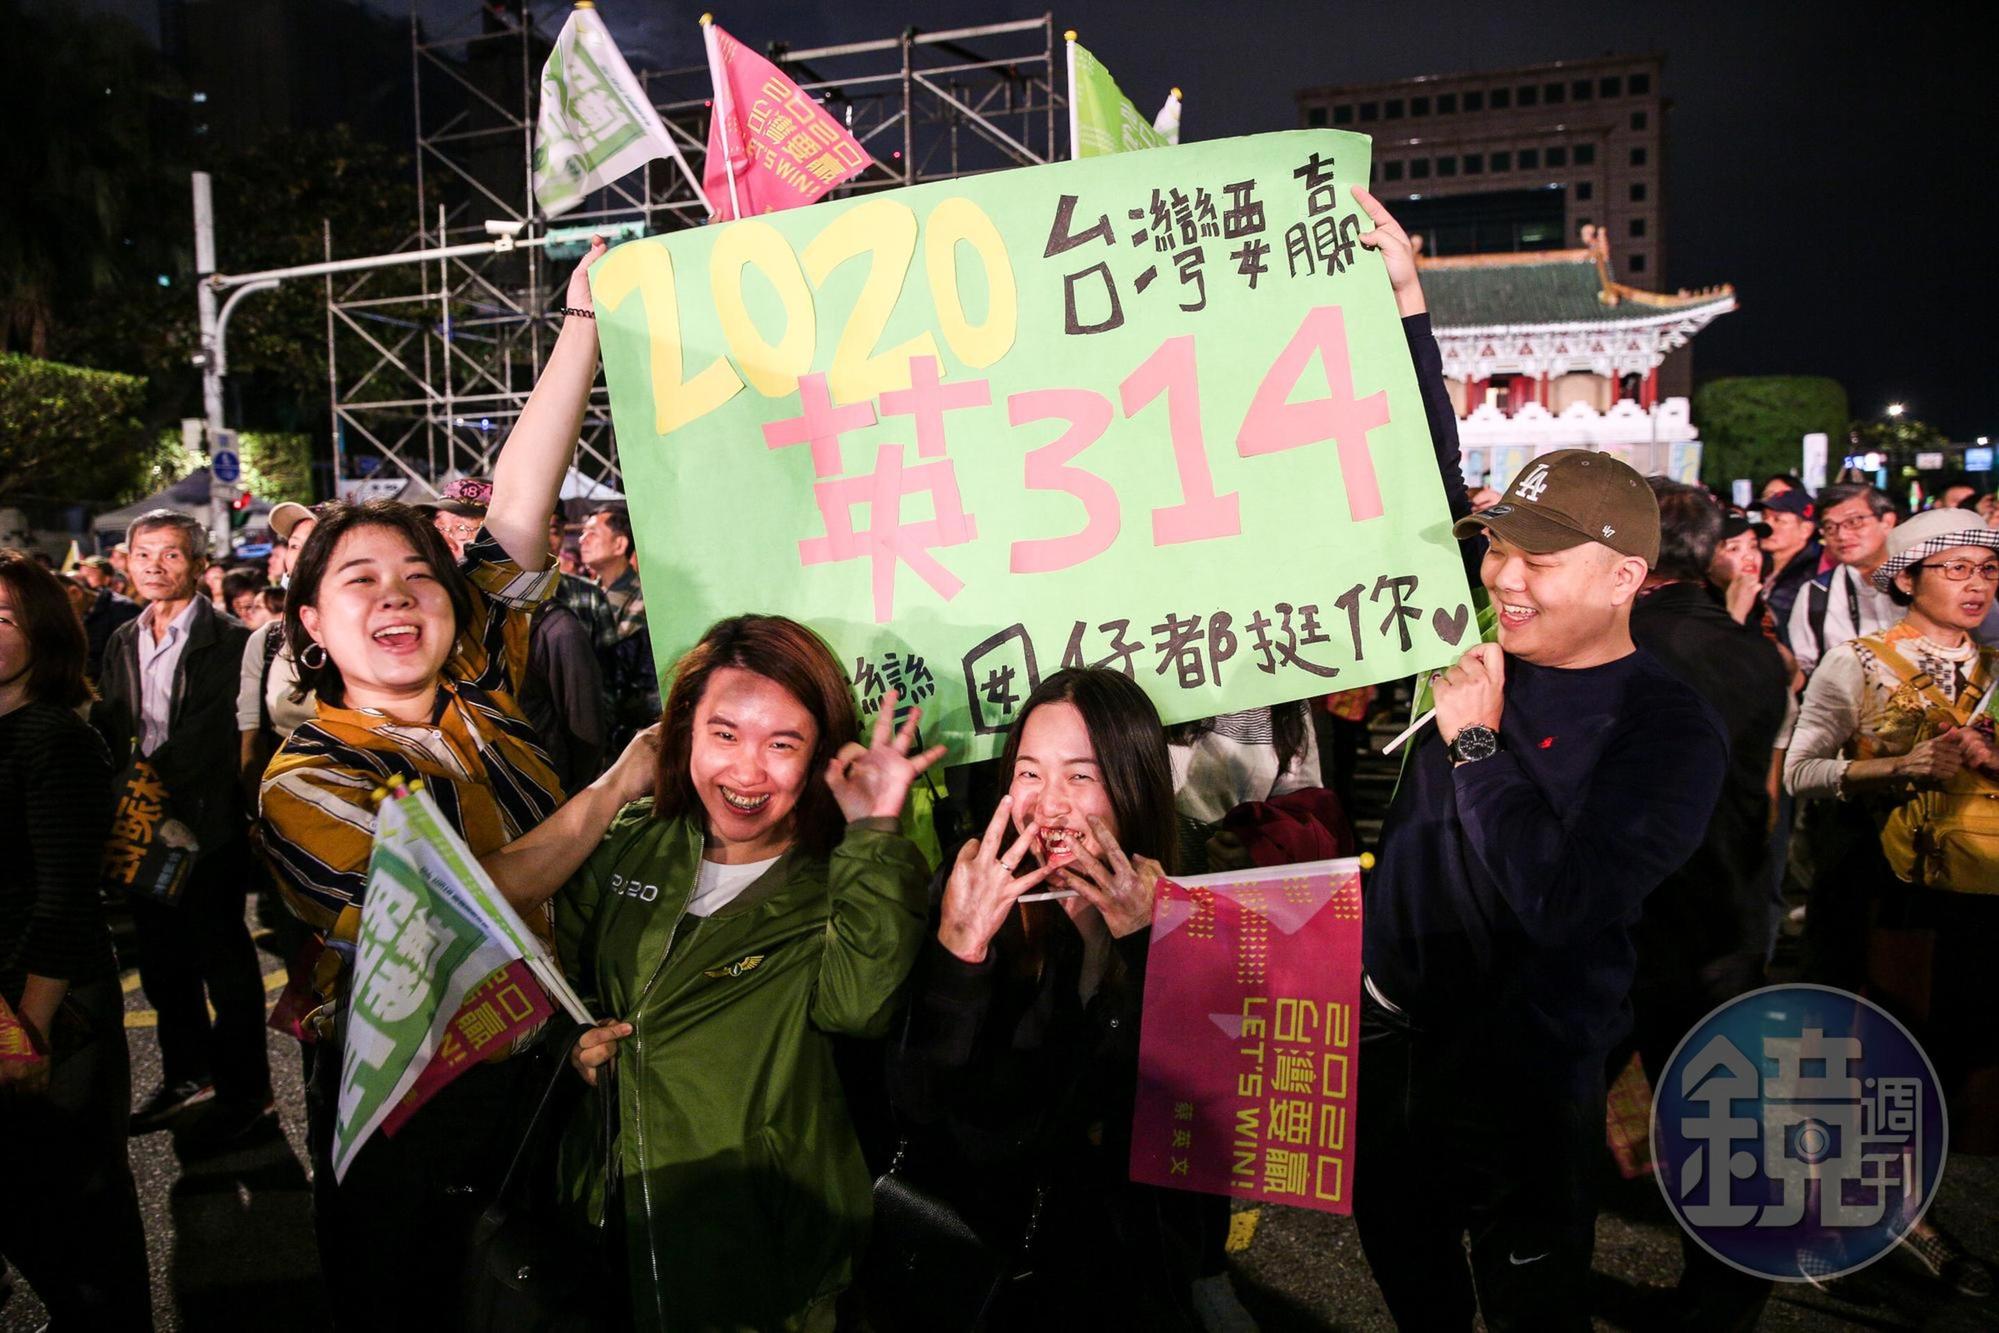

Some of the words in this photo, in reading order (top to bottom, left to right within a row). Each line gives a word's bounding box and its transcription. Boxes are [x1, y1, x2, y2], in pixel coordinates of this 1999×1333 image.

[747, 97, 847, 185] 台灣要贏
[762, 77, 863, 168] 2020
[776, 158, 821, 198] WIN!
[594, 197, 1018, 436] 2020
[1515, 464, 1550, 502] LA
[1238, 997, 1268, 1098] LET'S
[1263, 998, 1319, 1196] 台灣要贏
[1315, 1002, 1350, 1202] 2020
[1231, 1107, 1260, 1189] WIN!
